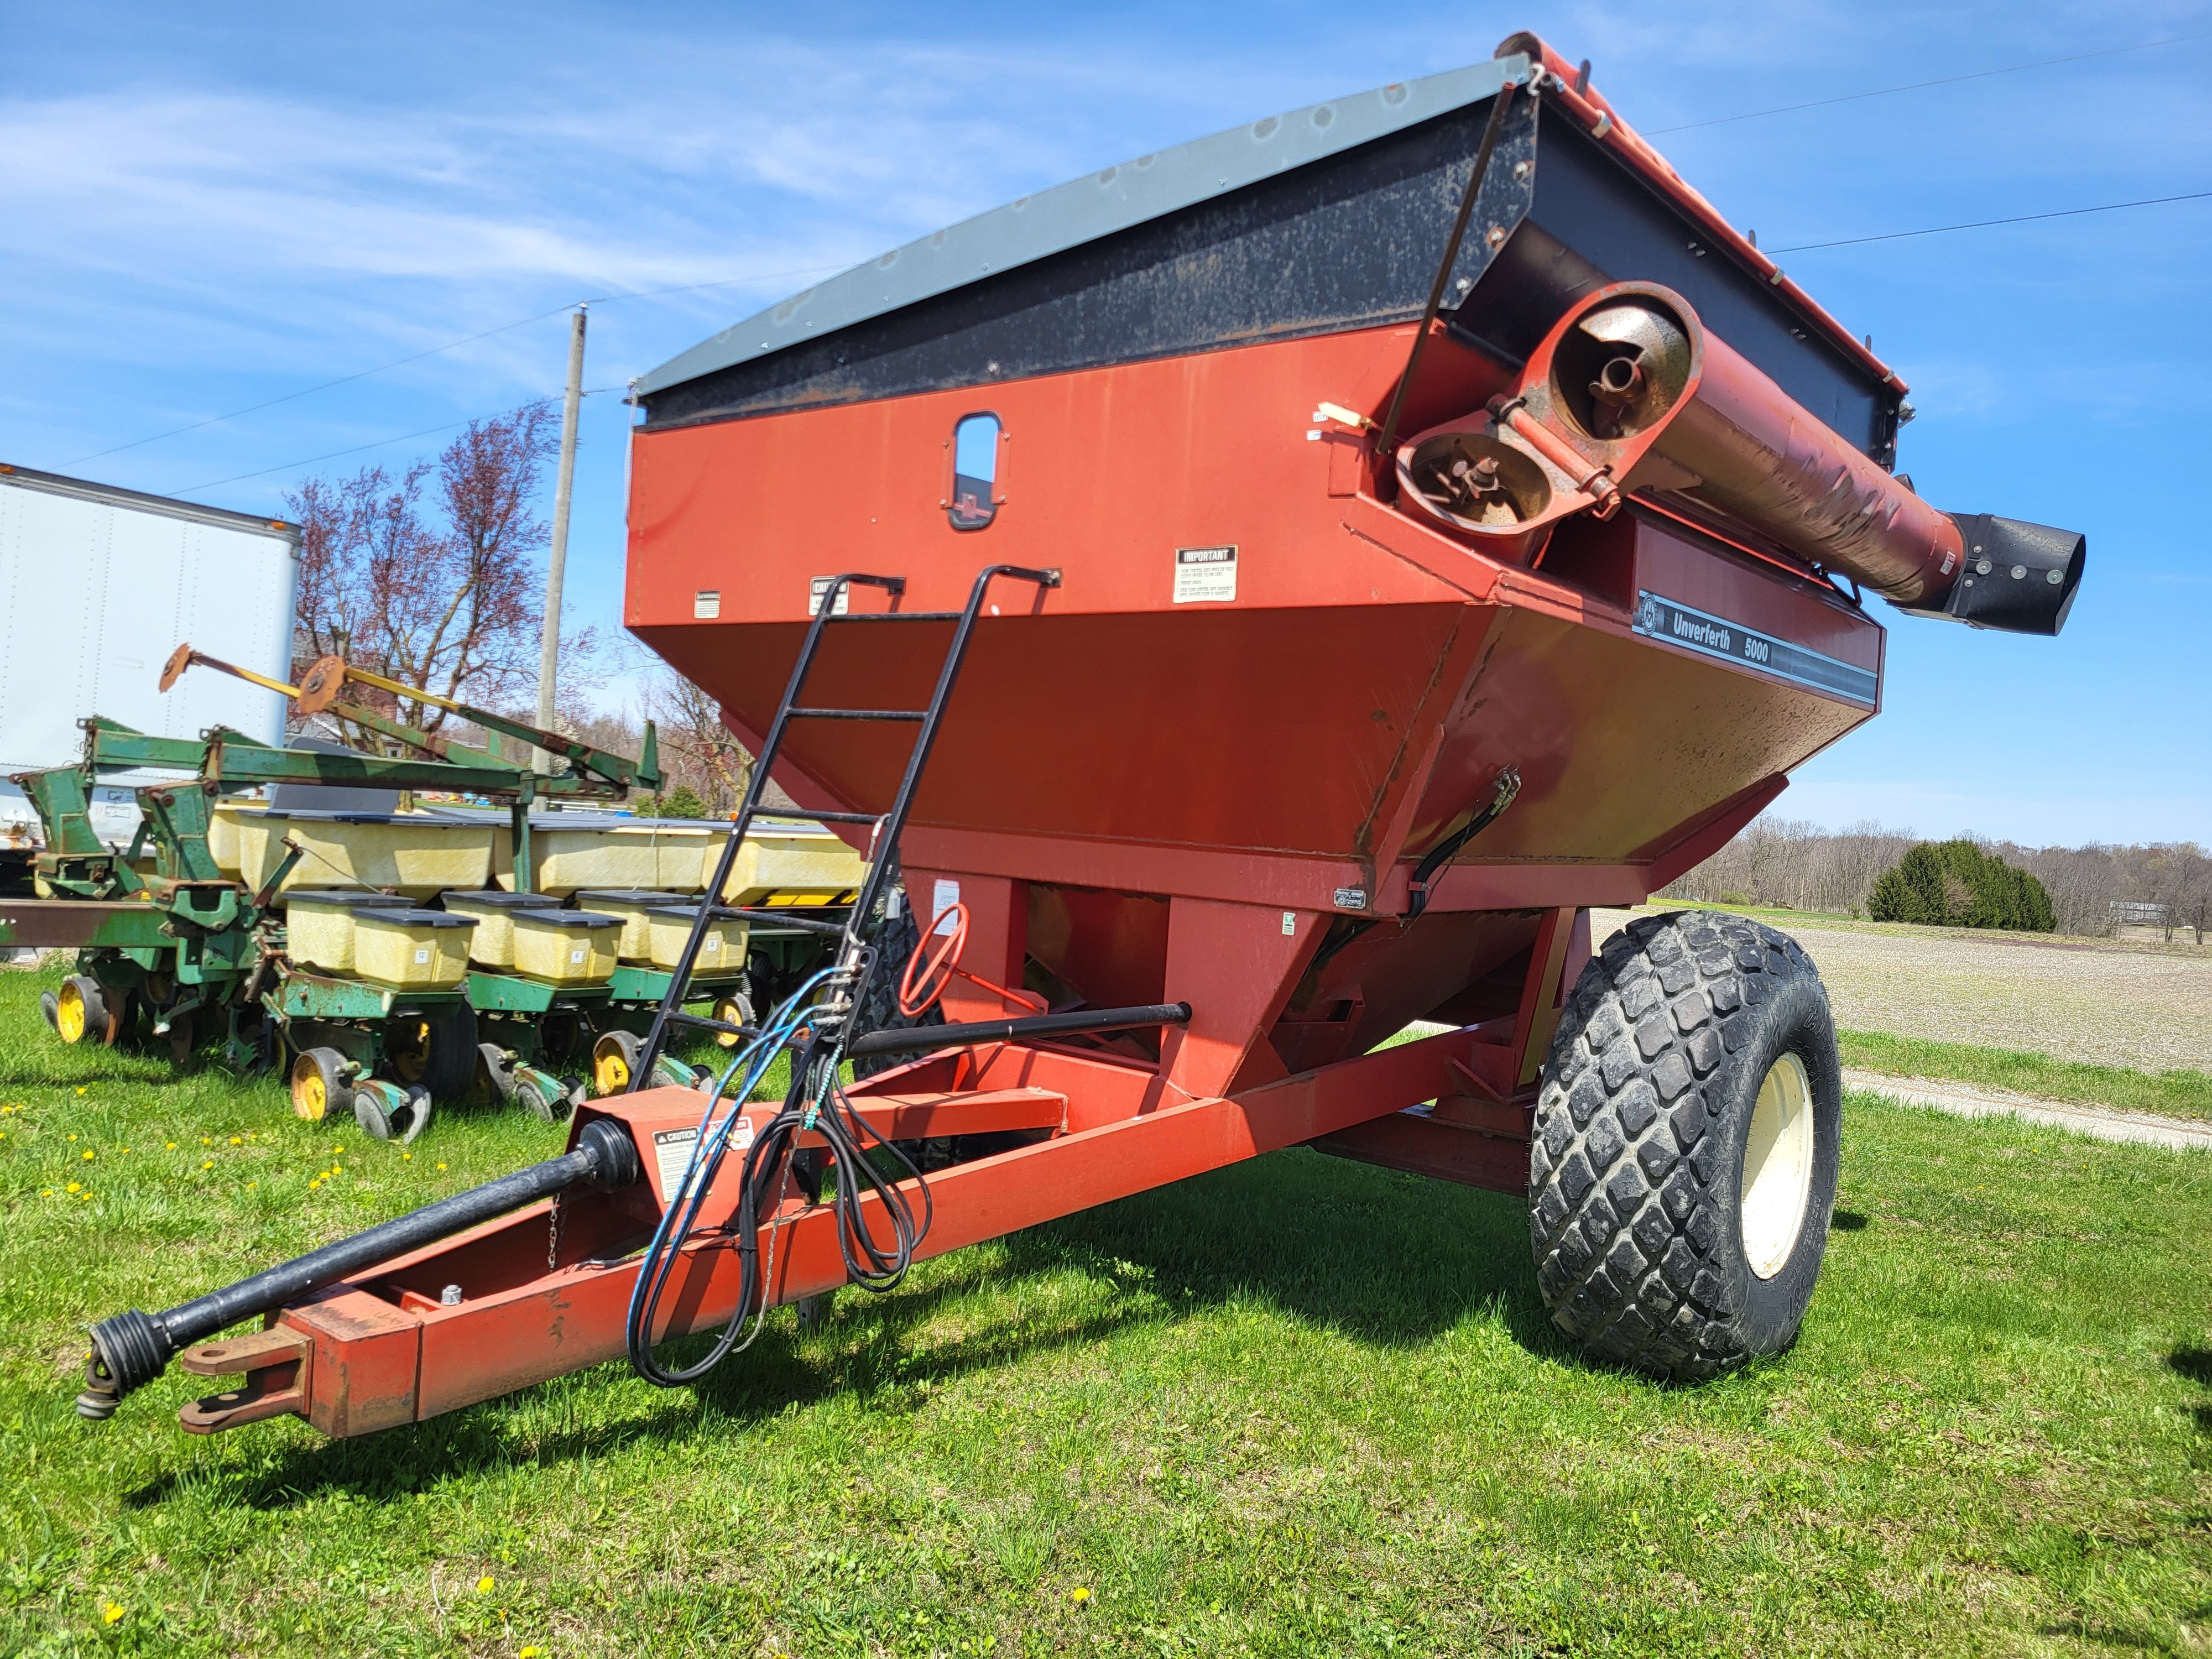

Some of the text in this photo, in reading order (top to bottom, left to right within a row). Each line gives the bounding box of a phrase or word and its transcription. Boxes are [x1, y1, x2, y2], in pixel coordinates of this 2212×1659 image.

[1184, 549, 1229, 562] IMPORTANT
[1673, 612, 1768, 662] Unverferth 5000
[666, 1129, 697, 1142] CAUTION
